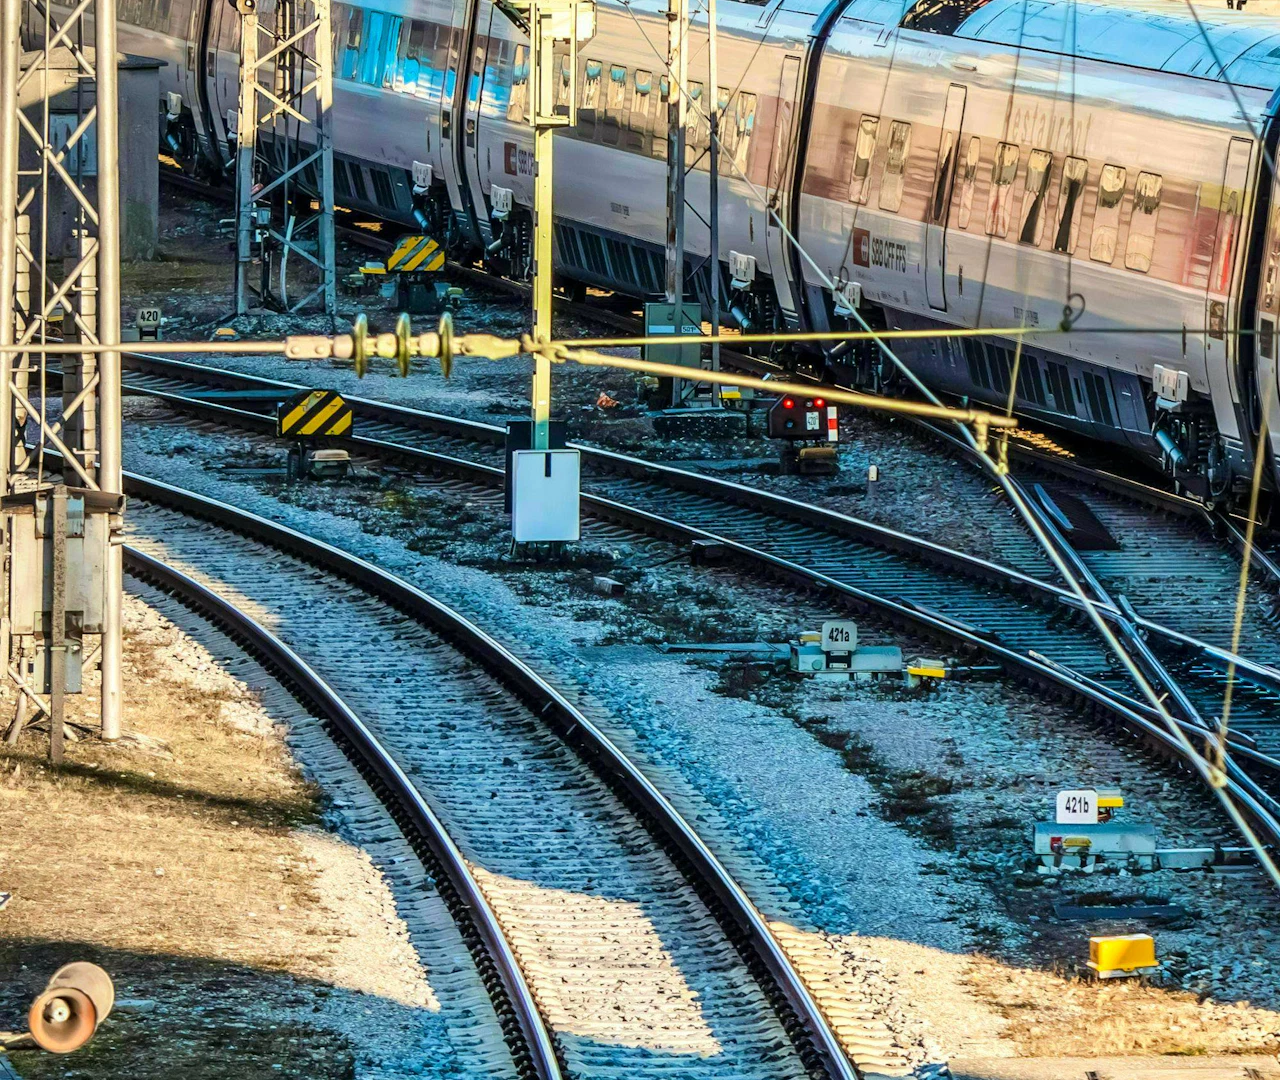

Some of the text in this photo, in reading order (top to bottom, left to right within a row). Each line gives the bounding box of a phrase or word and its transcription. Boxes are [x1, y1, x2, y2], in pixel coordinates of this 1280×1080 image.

[872, 237, 907, 273] SBB CFF FFS
[140, 311, 158, 321] 420
[829, 627, 850, 642] 421a
[1065, 796, 1089, 813] 421b
